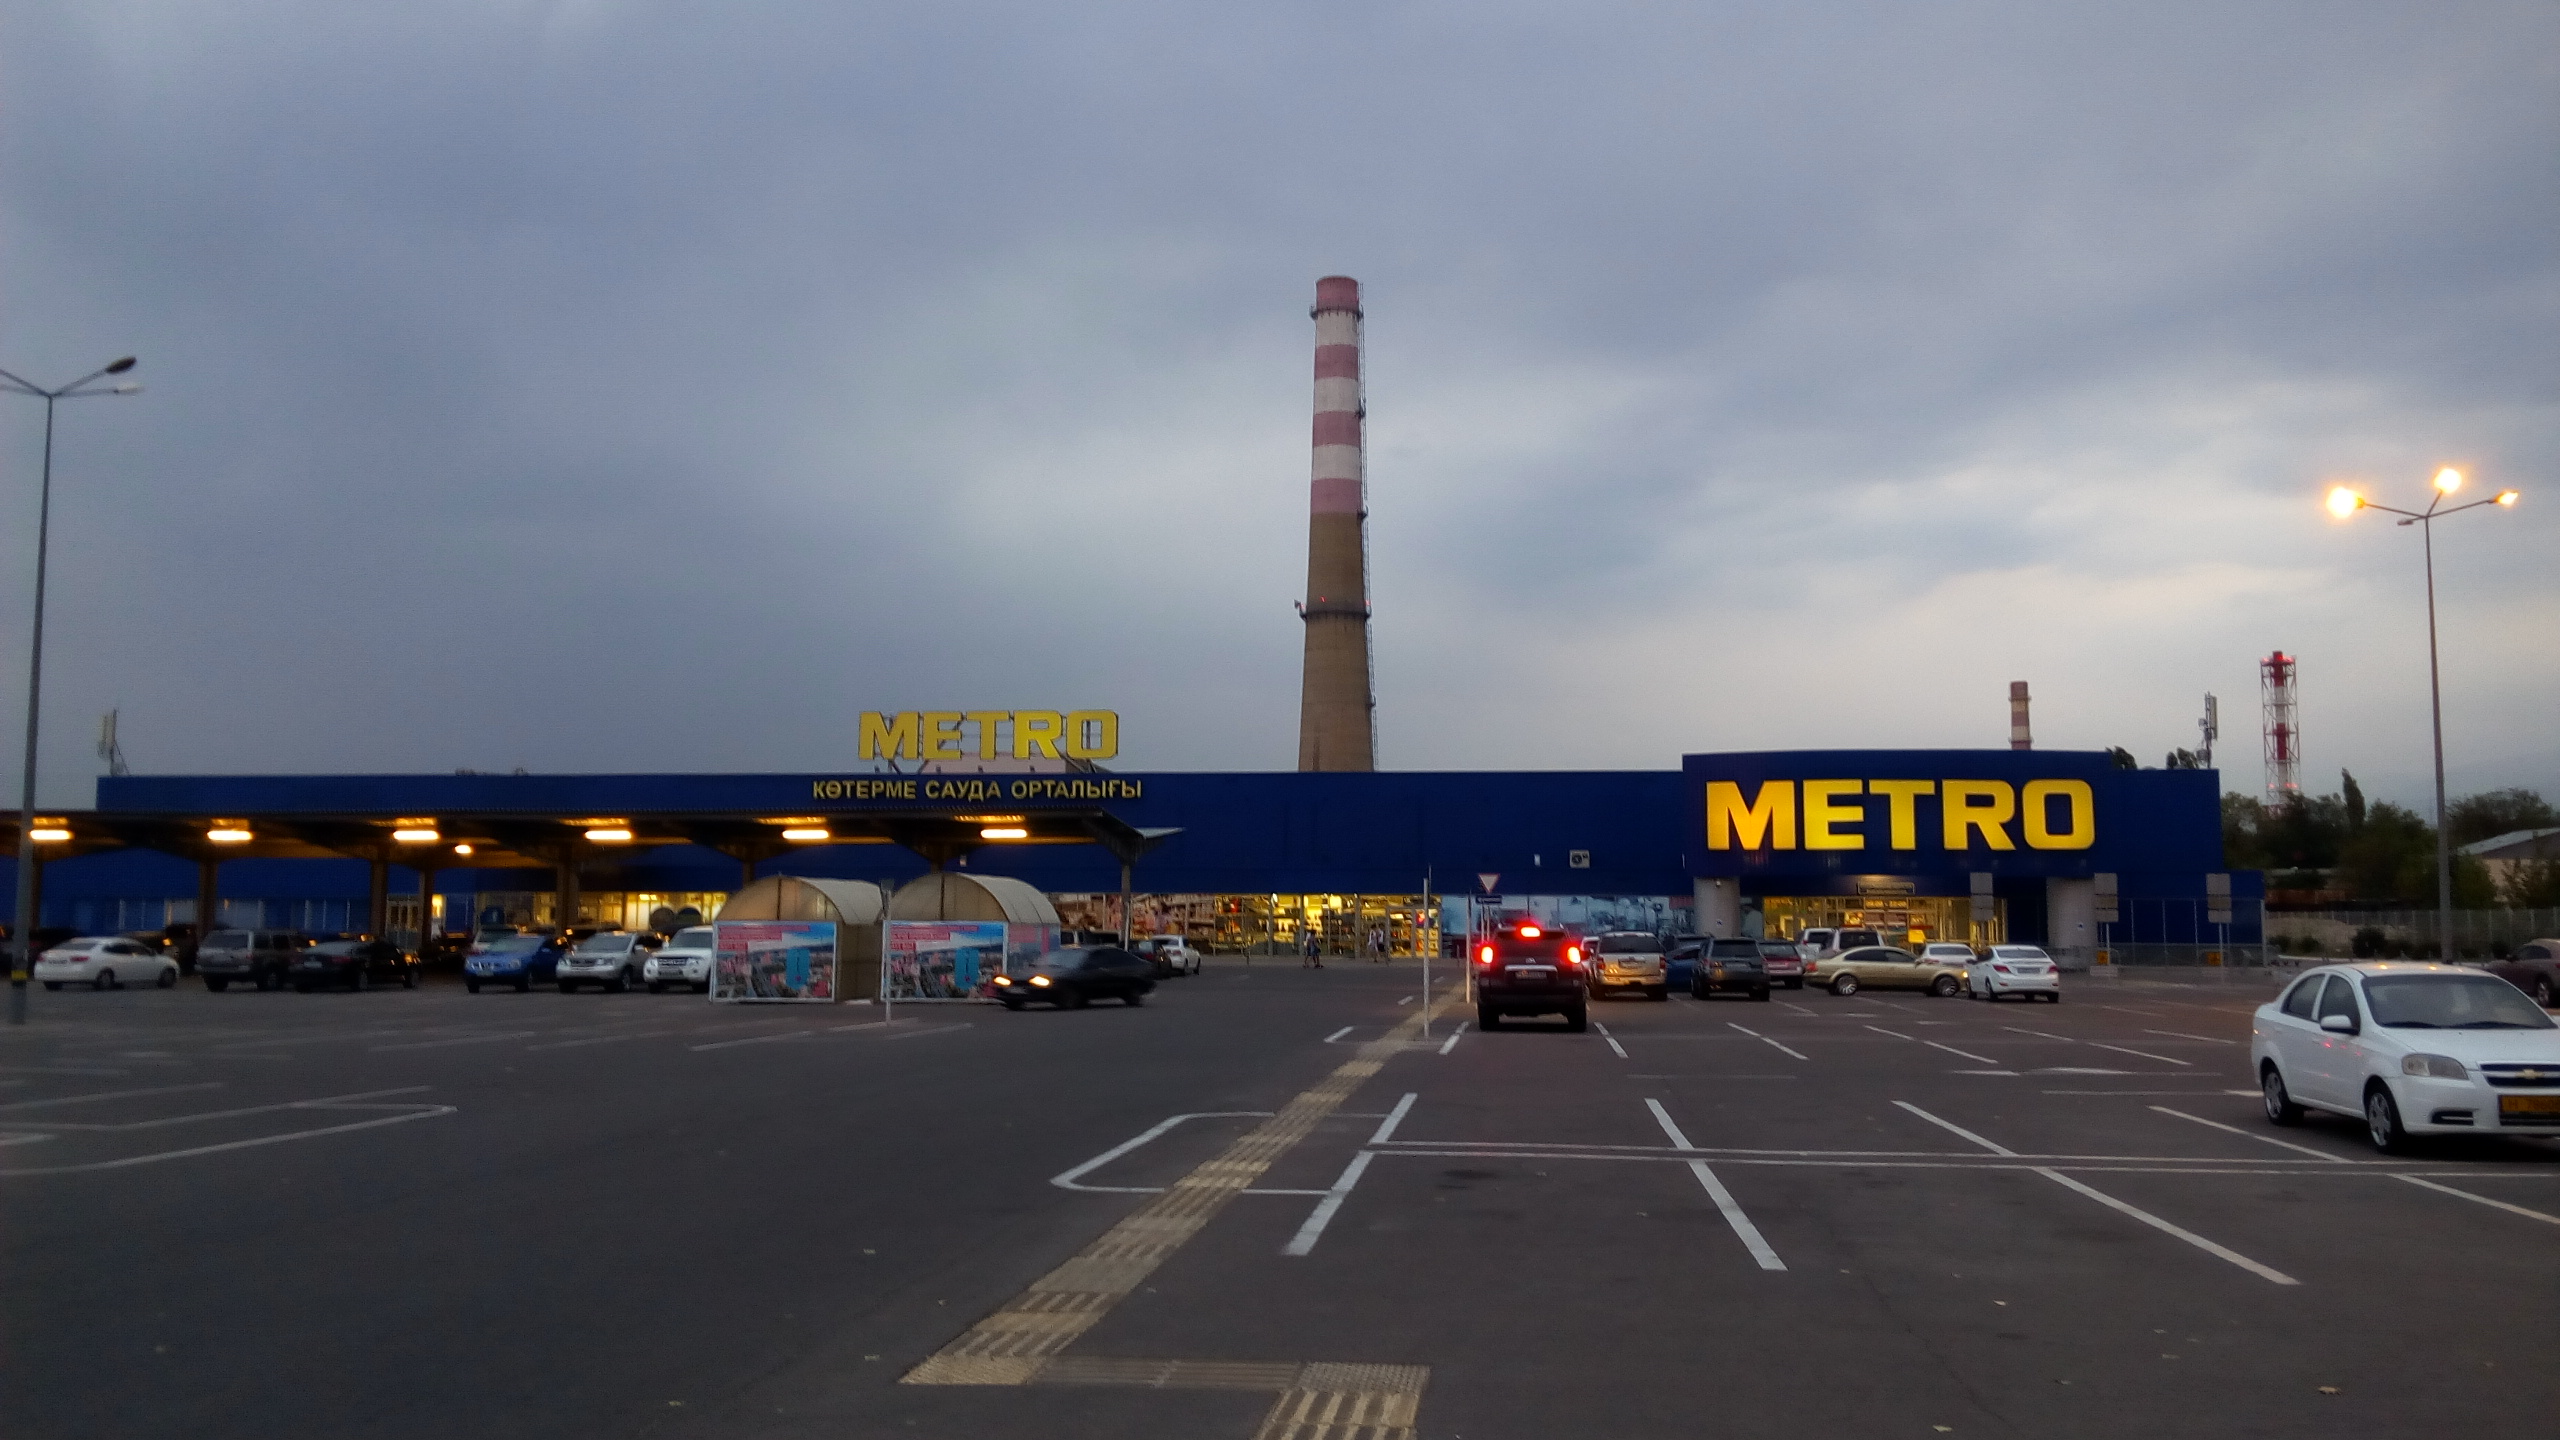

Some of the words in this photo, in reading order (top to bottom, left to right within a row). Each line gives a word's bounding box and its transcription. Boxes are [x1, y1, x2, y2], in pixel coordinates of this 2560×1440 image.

[858, 709, 1119, 761] METRO
[812, 780, 917, 800] КӨТЕРМЕ
[925, 780, 1002, 802] САУДА
[1010, 779, 1143, 800] ОРТАЛЫҒЫ
[1705, 779, 2096, 851] METRO
